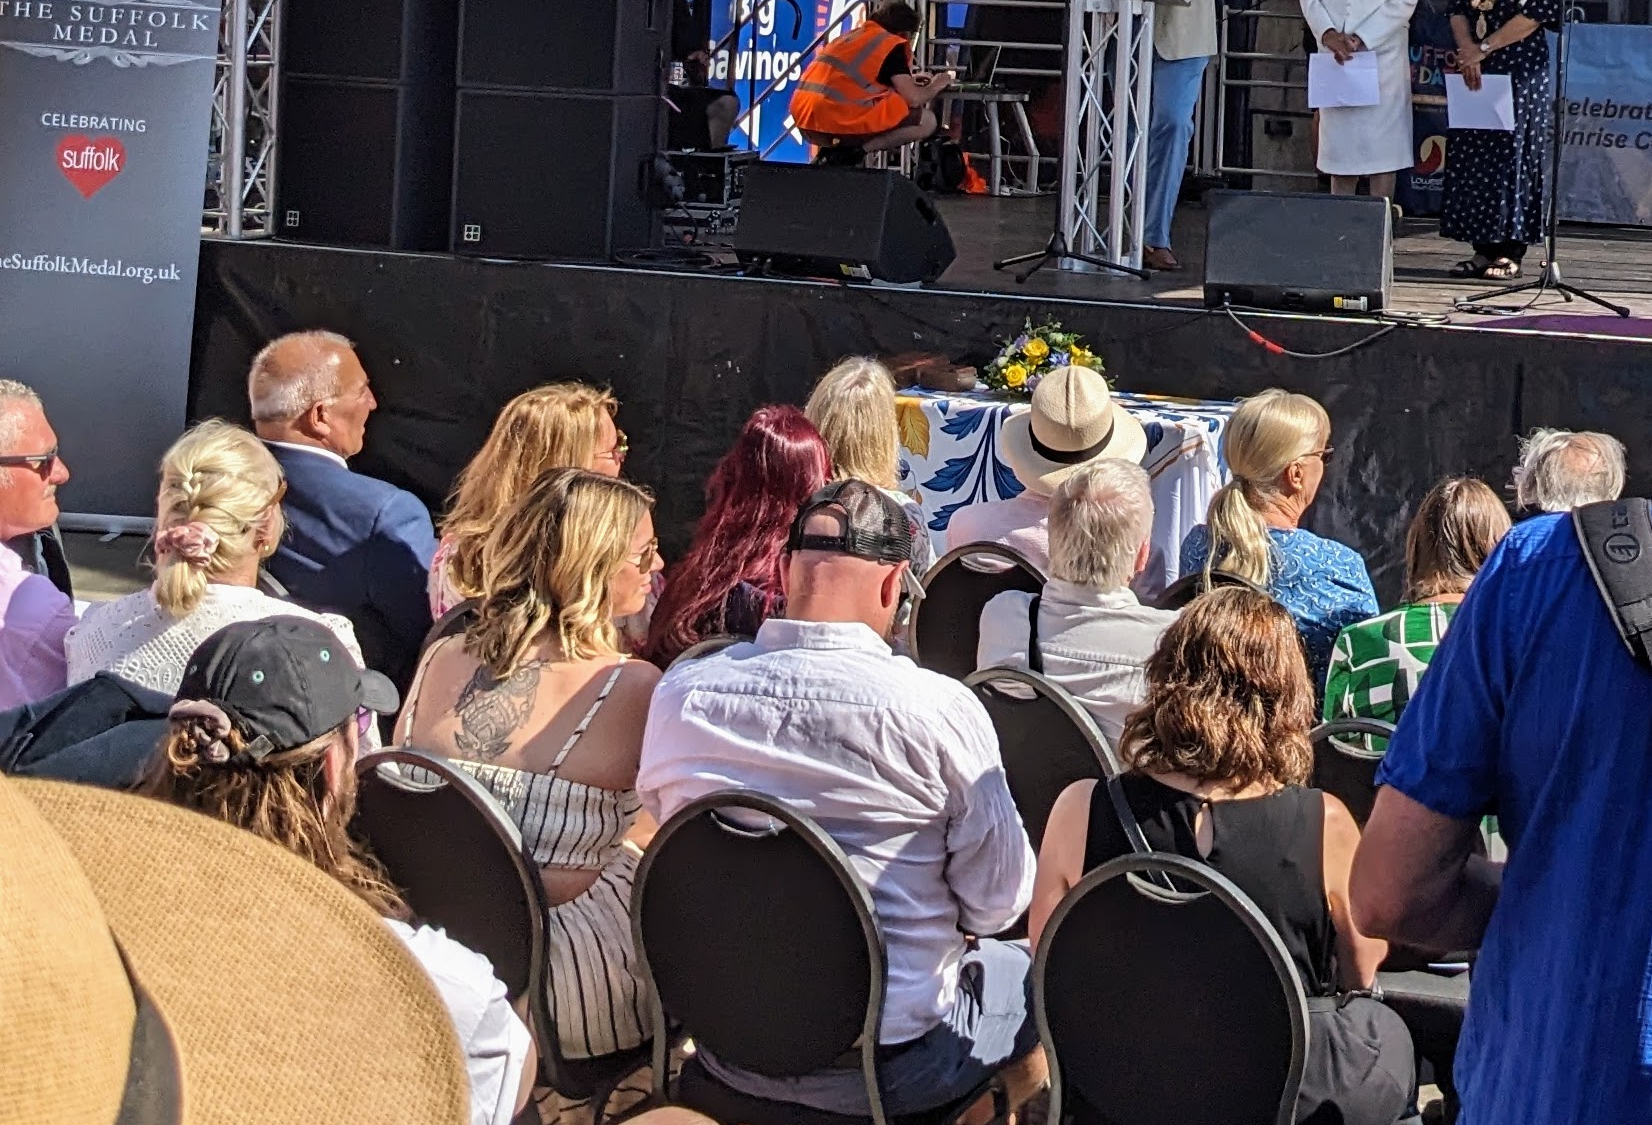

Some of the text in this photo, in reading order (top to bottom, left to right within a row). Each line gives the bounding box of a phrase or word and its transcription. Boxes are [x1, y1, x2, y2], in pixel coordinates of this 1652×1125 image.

[70, 6, 210, 31] SUFFOLK
[52, 24, 159, 48] MEDAL
[41, 112, 147, 132] CELEBRATING
[61, 147, 121, 173] suffolk
